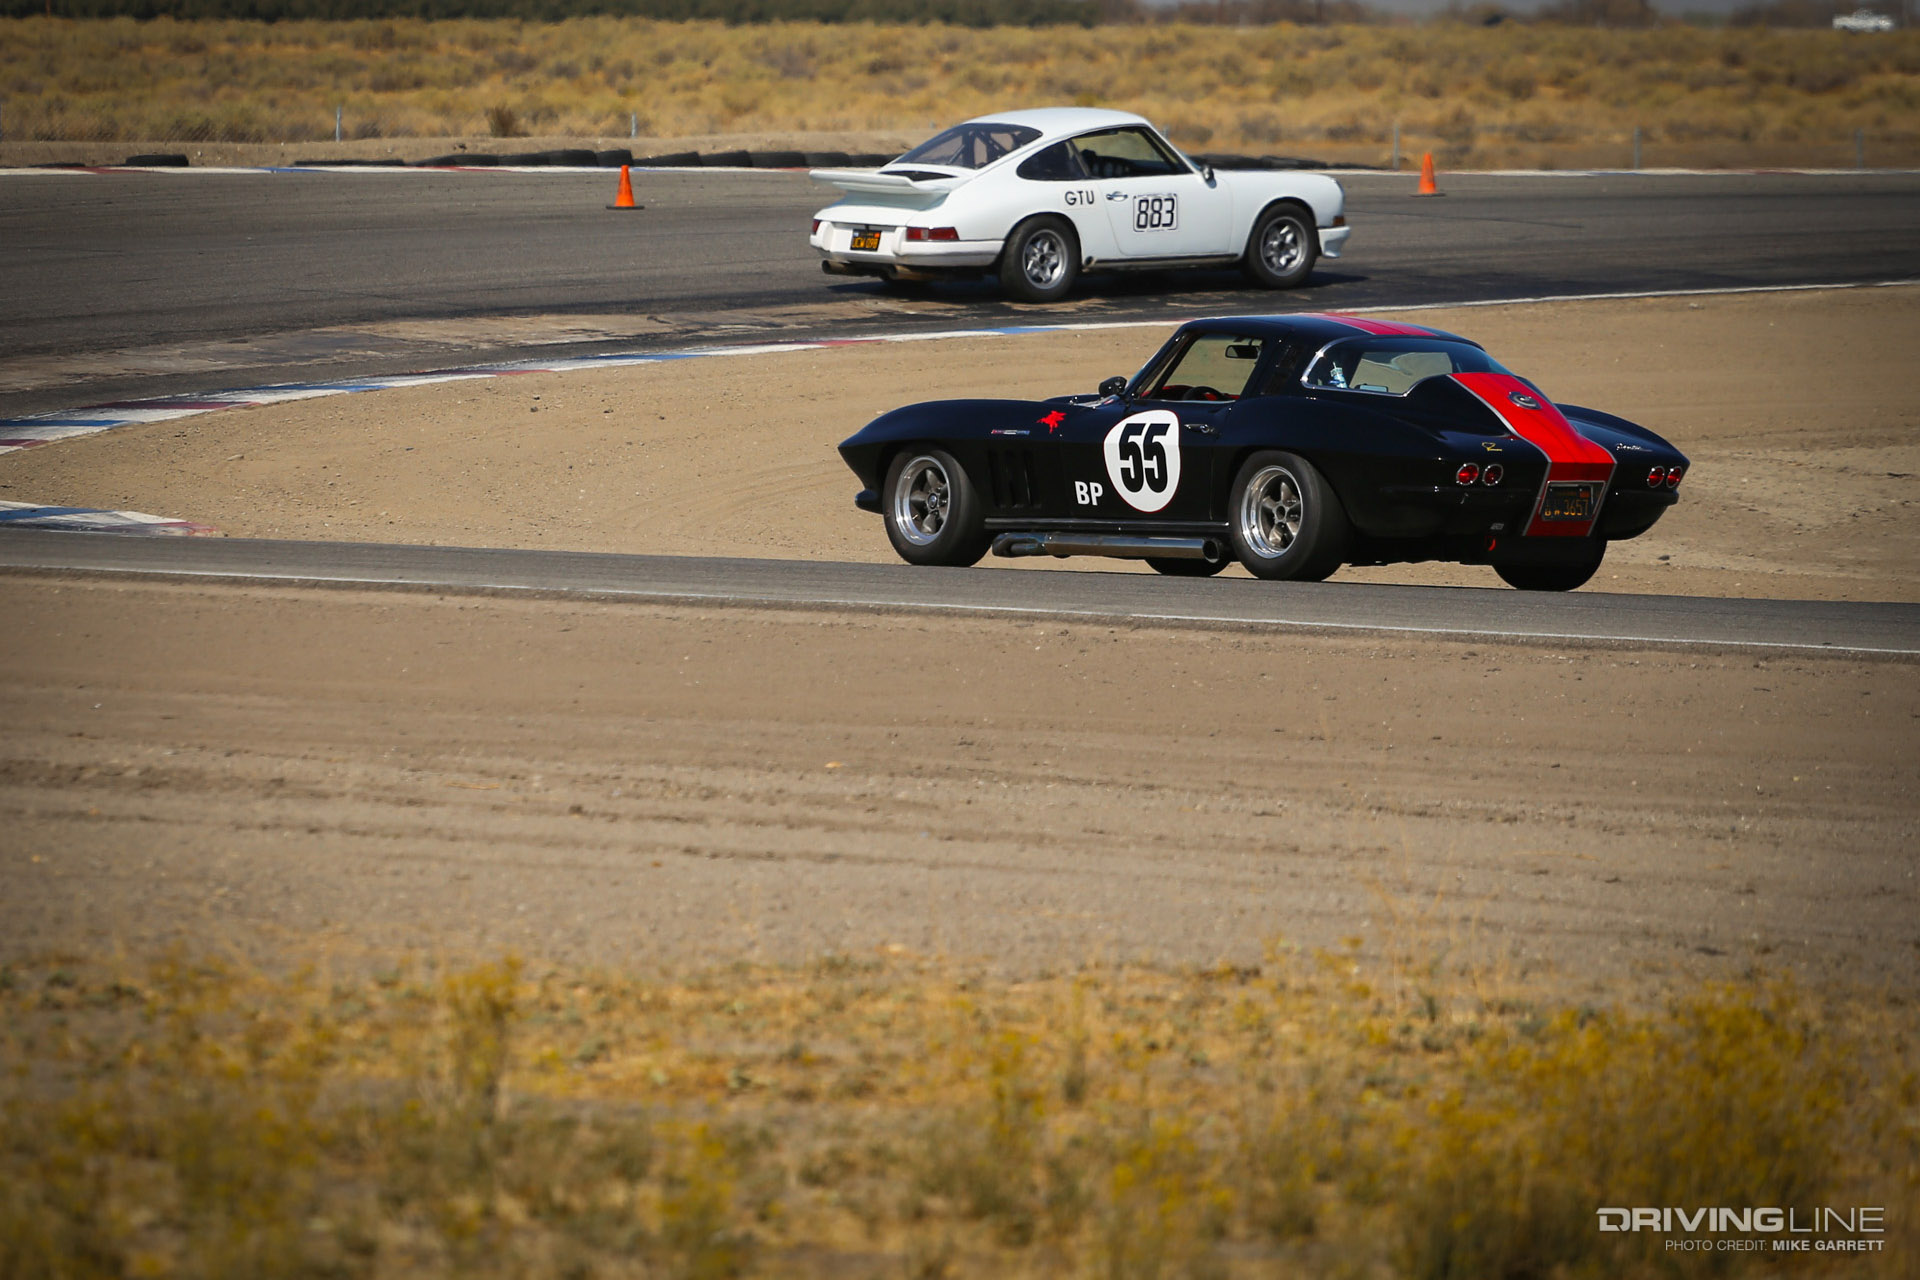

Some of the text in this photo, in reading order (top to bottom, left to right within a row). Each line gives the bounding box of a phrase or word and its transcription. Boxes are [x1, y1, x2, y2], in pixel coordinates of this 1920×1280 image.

[1064, 190, 1095, 206] GTU
[1136, 197, 1175, 229] 883
[1118, 423, 1171, 493] 55
[1074, 480, 1104, 506] BP
